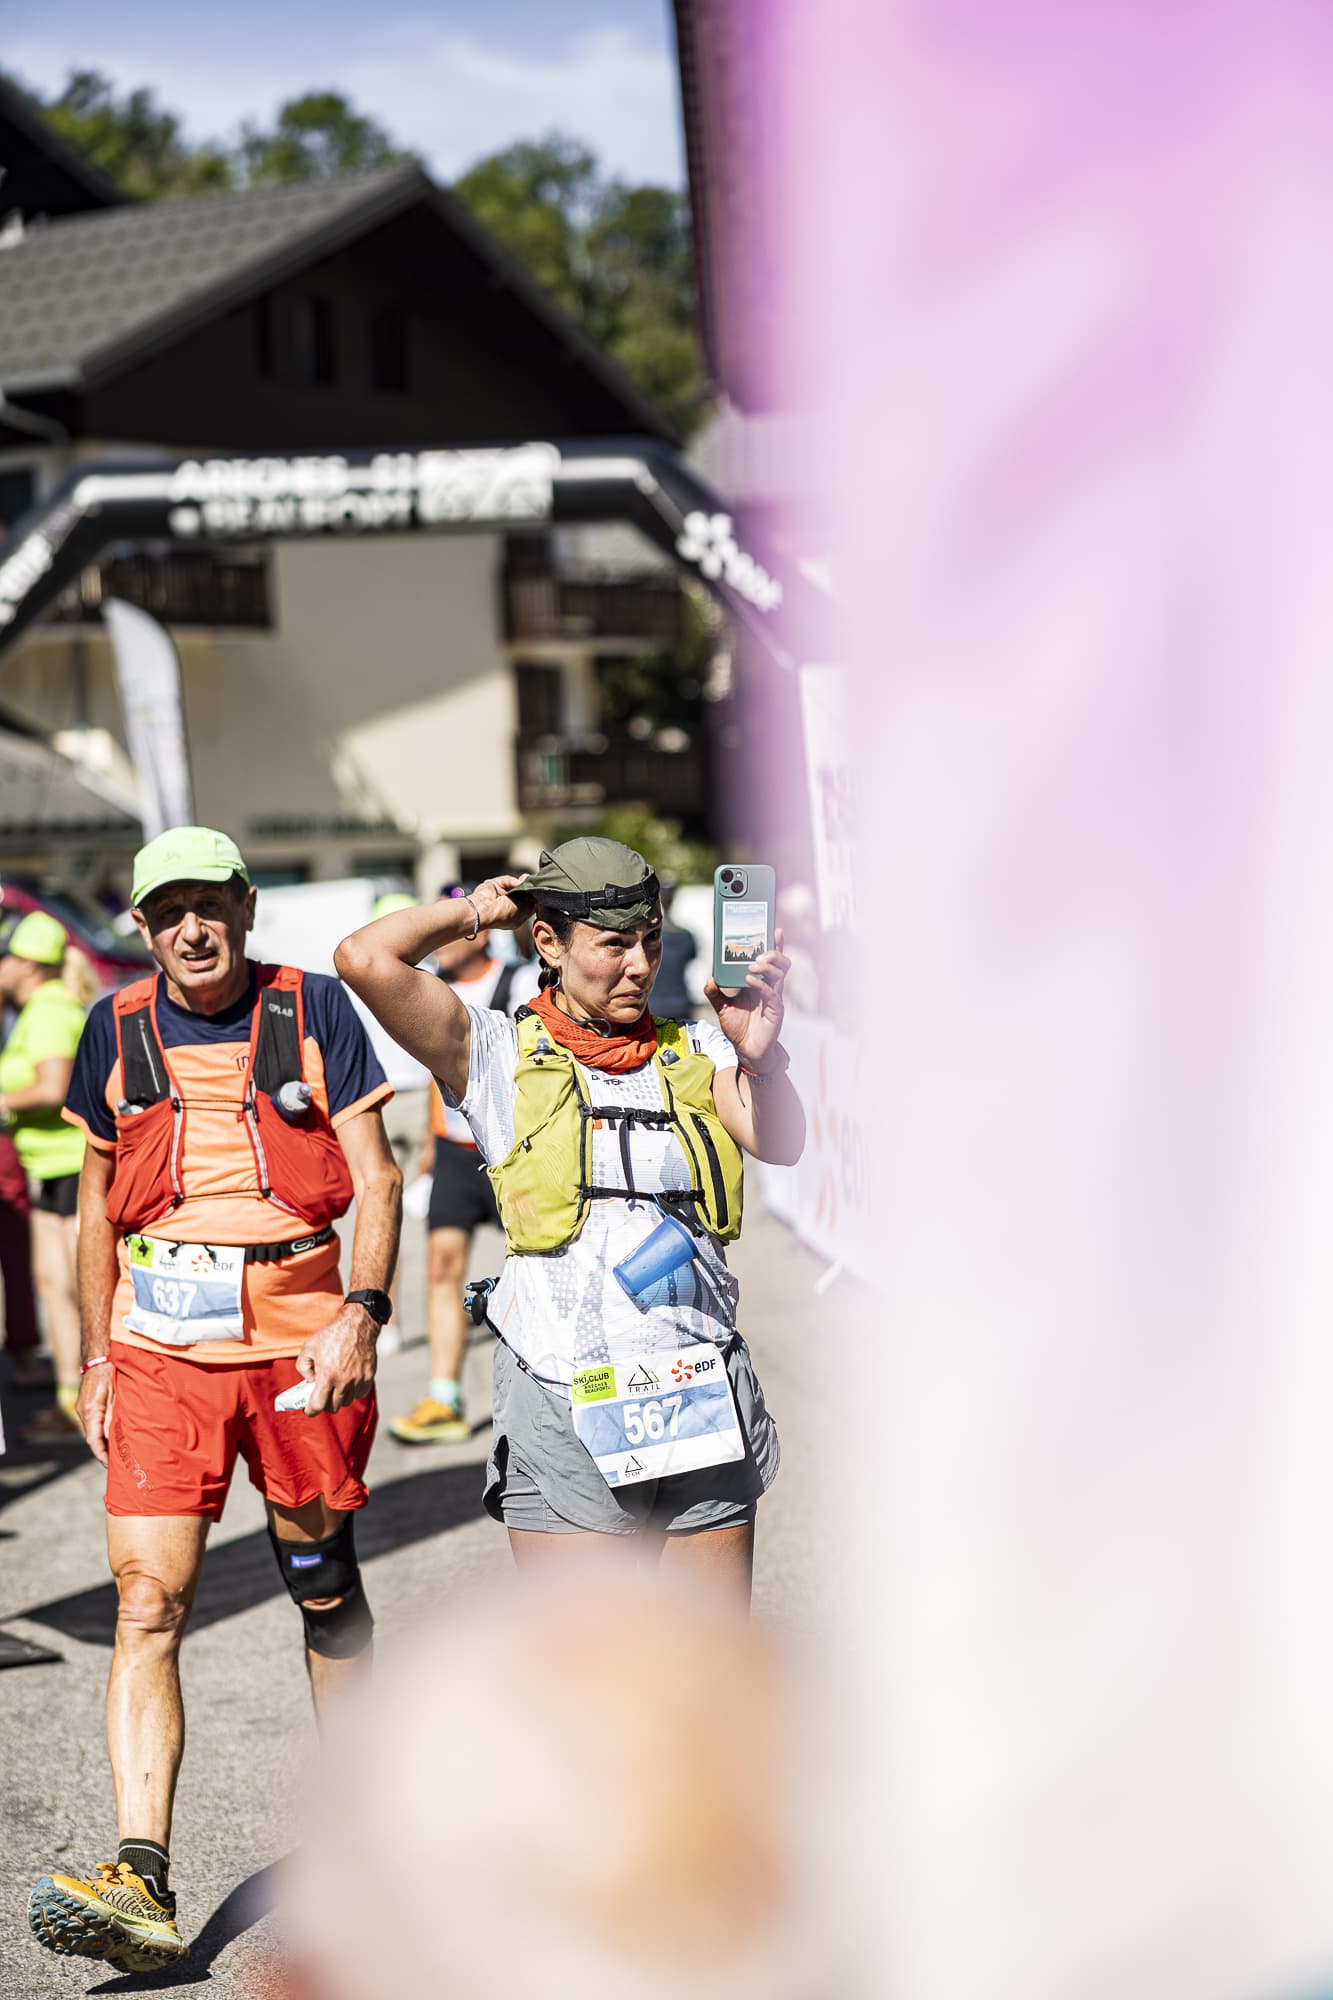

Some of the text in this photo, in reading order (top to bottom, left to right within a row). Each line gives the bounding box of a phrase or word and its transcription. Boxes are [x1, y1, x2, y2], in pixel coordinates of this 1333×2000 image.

[152, 1278, 198, 1318] 637
[588, 1372, 610, 1383] CLUB
[628, 1383, 662, 1393] TRAIL
[623, 1395, 683, 1445] 567
